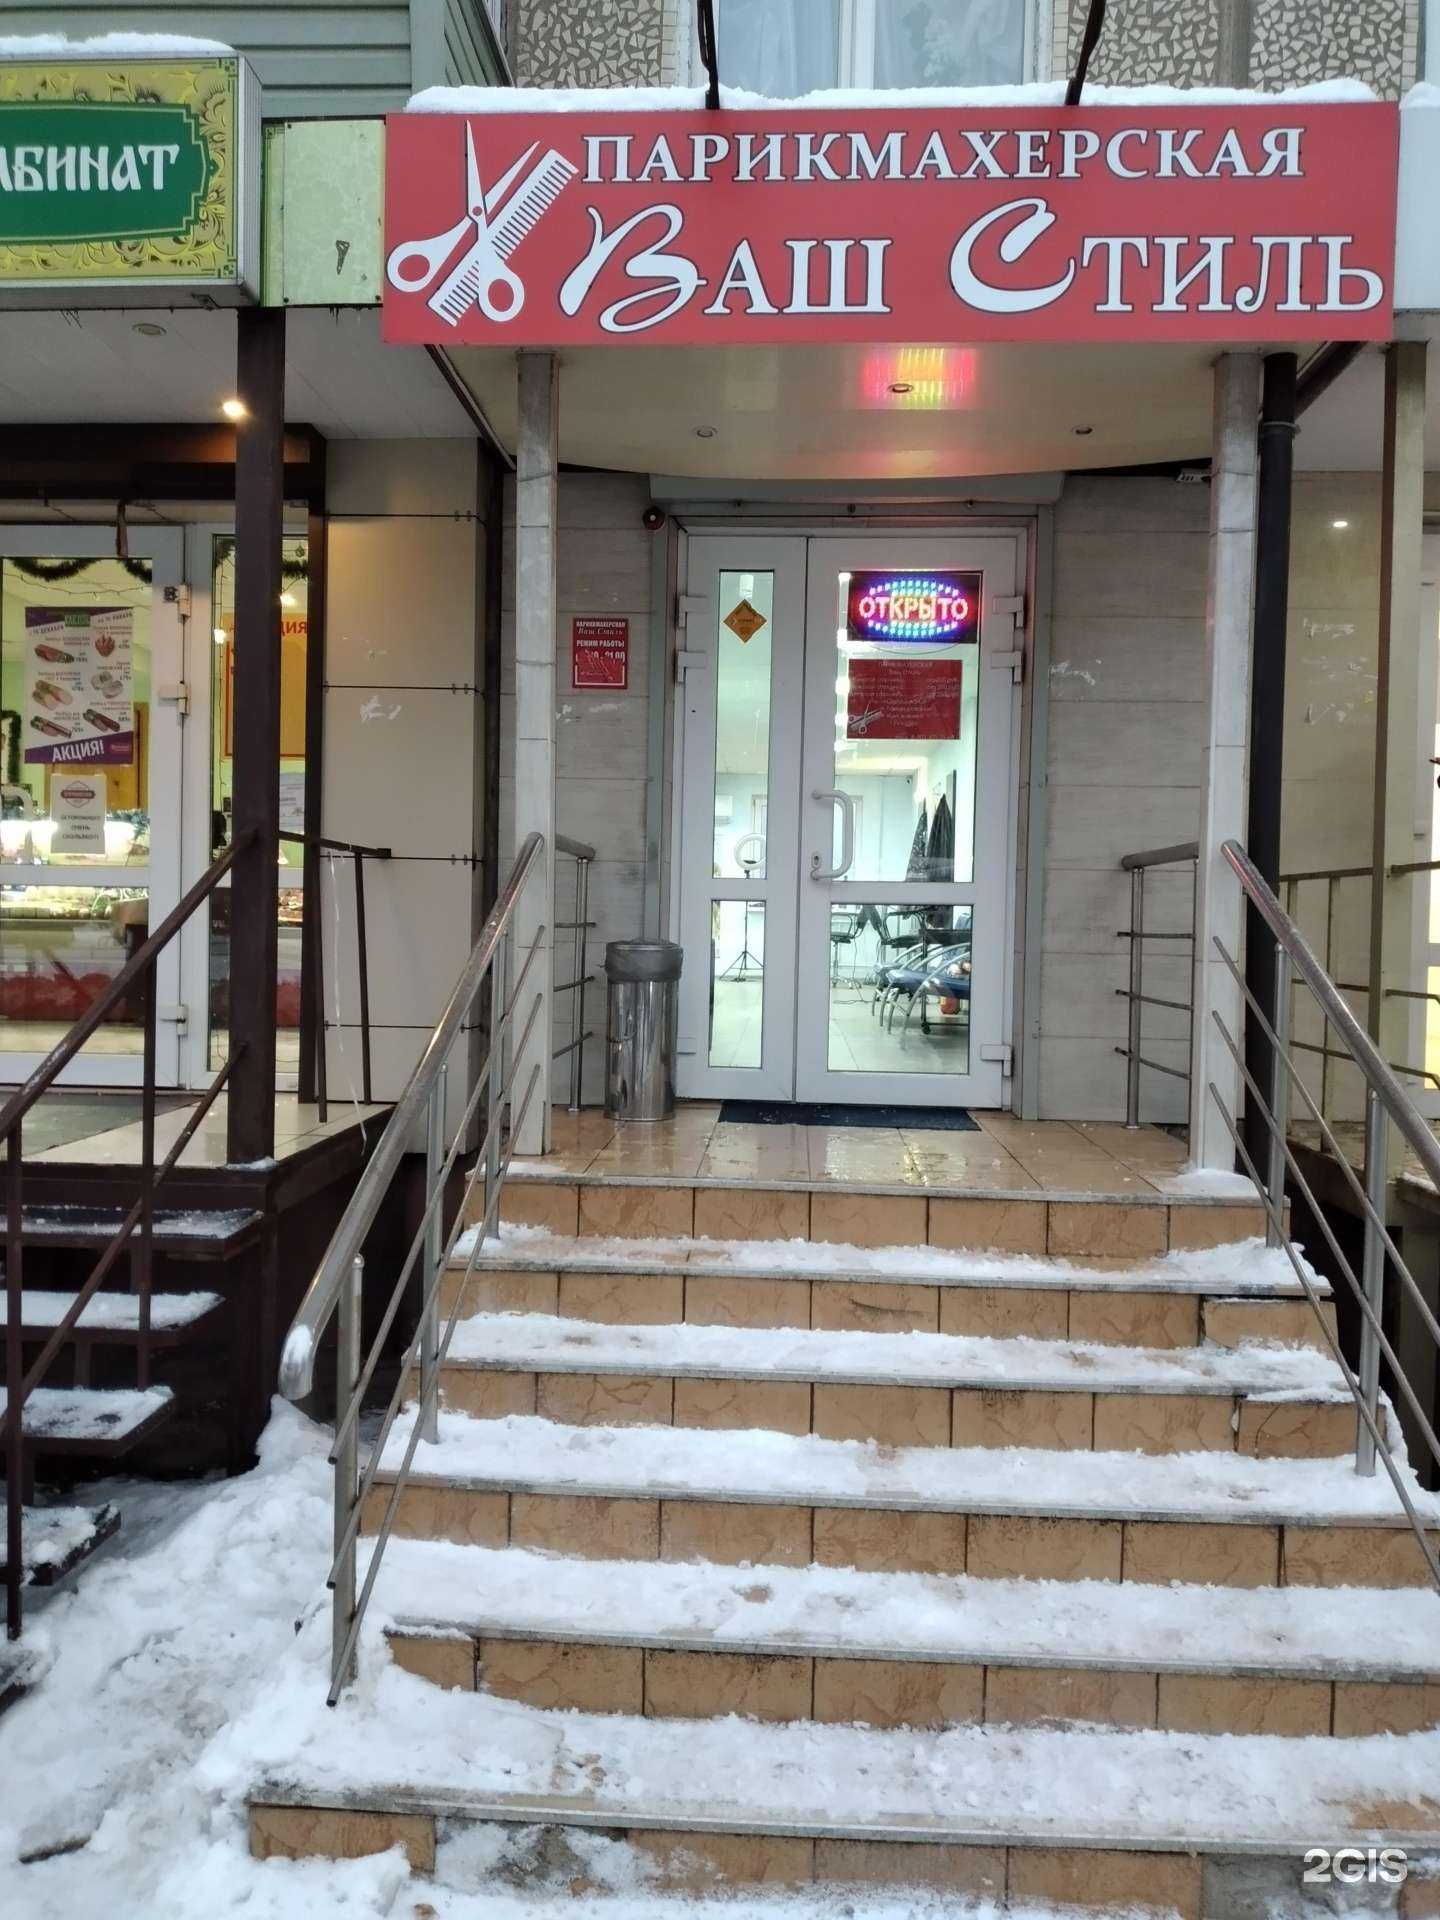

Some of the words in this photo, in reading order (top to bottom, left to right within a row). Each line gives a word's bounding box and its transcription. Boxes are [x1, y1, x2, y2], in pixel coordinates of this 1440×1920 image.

[582, 127, 1306, 183] ПАРИКМАХЕРСКАЯ
[858, 596, 968, 621] ОТКРЫТО
[599, 640, 625, 648] РАБОТЫ
[52, 740, 105, 763] АКЦИЯ!
